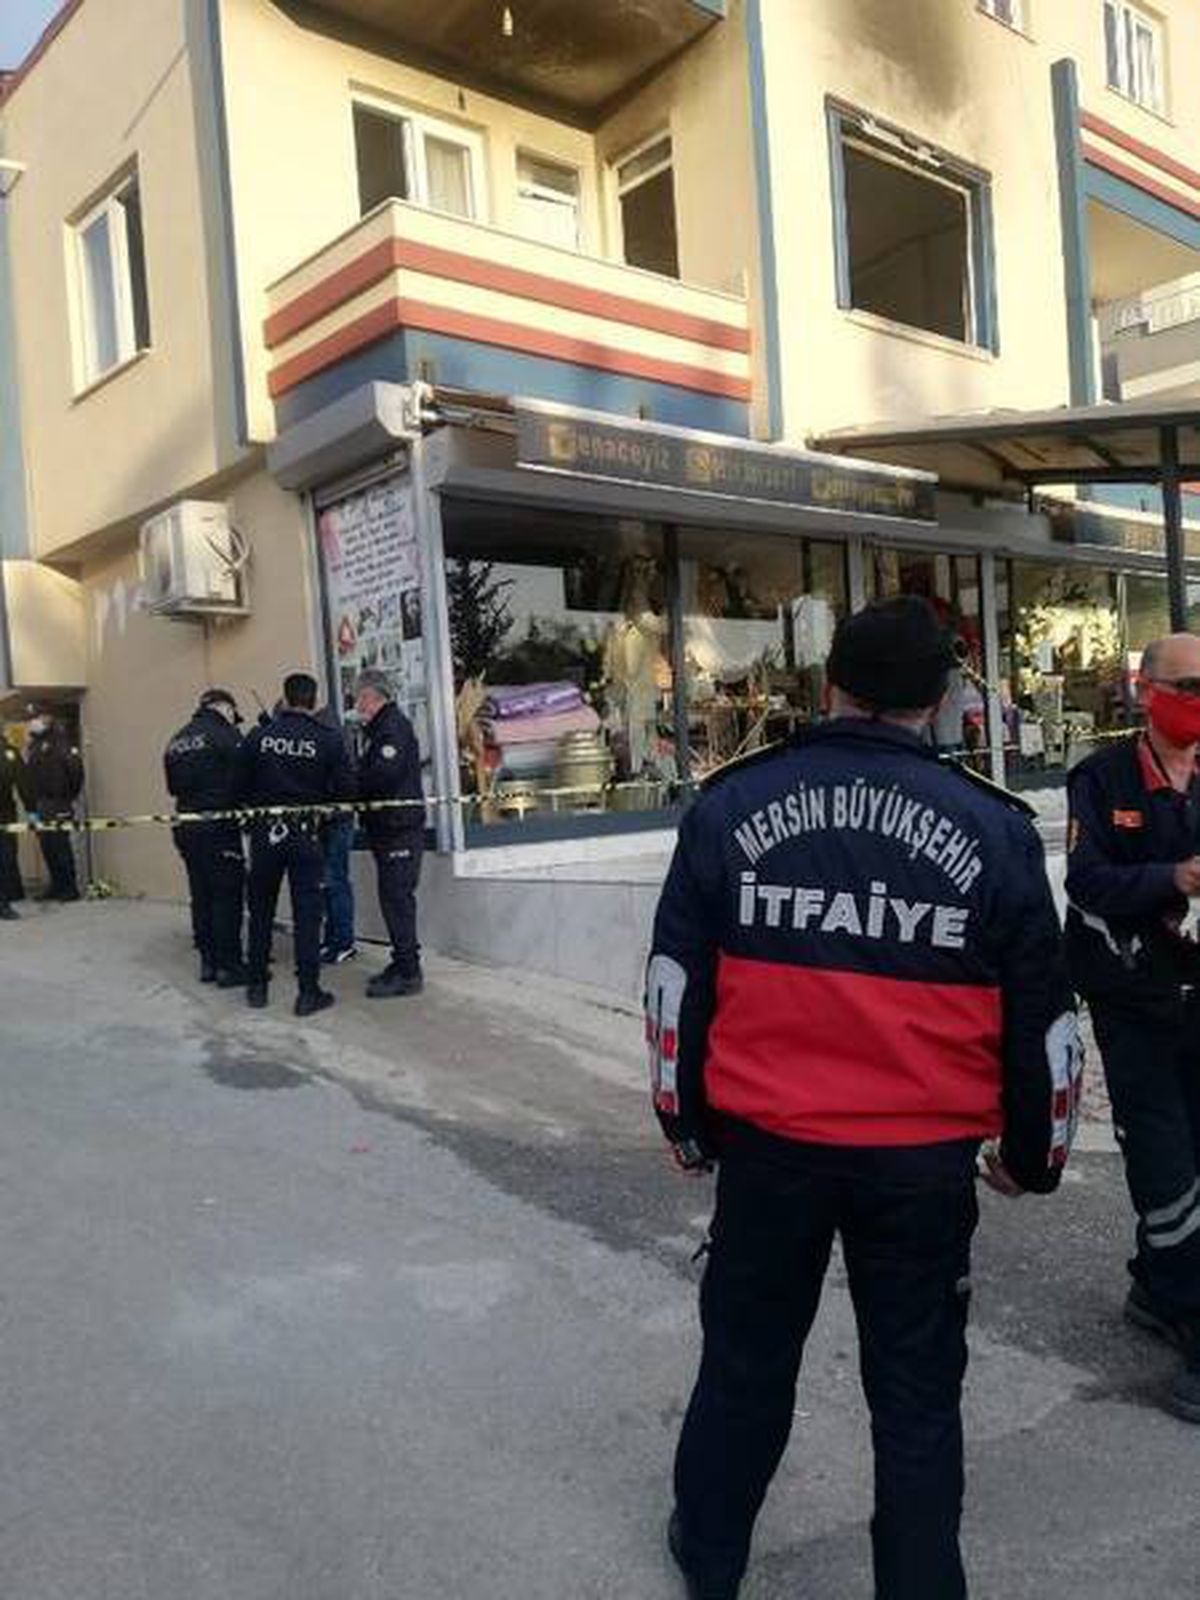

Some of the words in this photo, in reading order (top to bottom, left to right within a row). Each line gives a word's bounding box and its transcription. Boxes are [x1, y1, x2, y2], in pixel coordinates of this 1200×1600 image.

[734, 784, 825, 864] MERSİN
[833, 778, 983, 894] BÜYÜKŞEHİR
[739, 871, 969, 949] İTFAİYE
